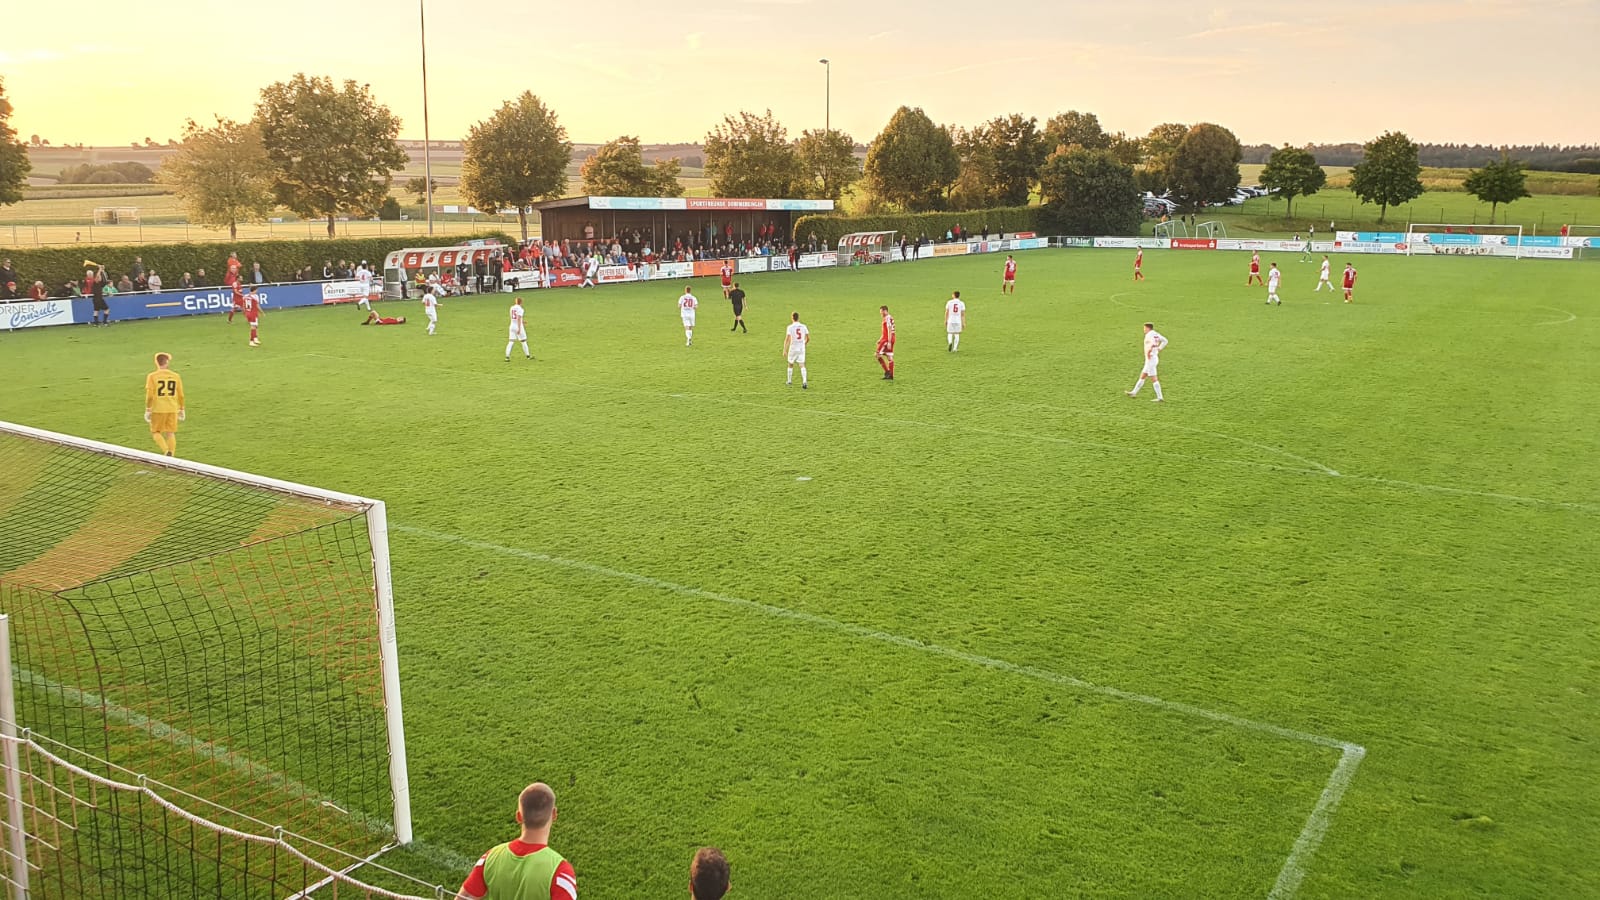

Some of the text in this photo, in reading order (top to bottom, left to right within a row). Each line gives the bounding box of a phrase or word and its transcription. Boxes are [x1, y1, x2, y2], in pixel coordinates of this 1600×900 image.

[683, 298, 693, 308] 20
[953, 303, 959, 313] 6
[10, 302, 58, 328] Consult
[796, 328, 802, 340] 5
[157, 380, 177, 397] 29
